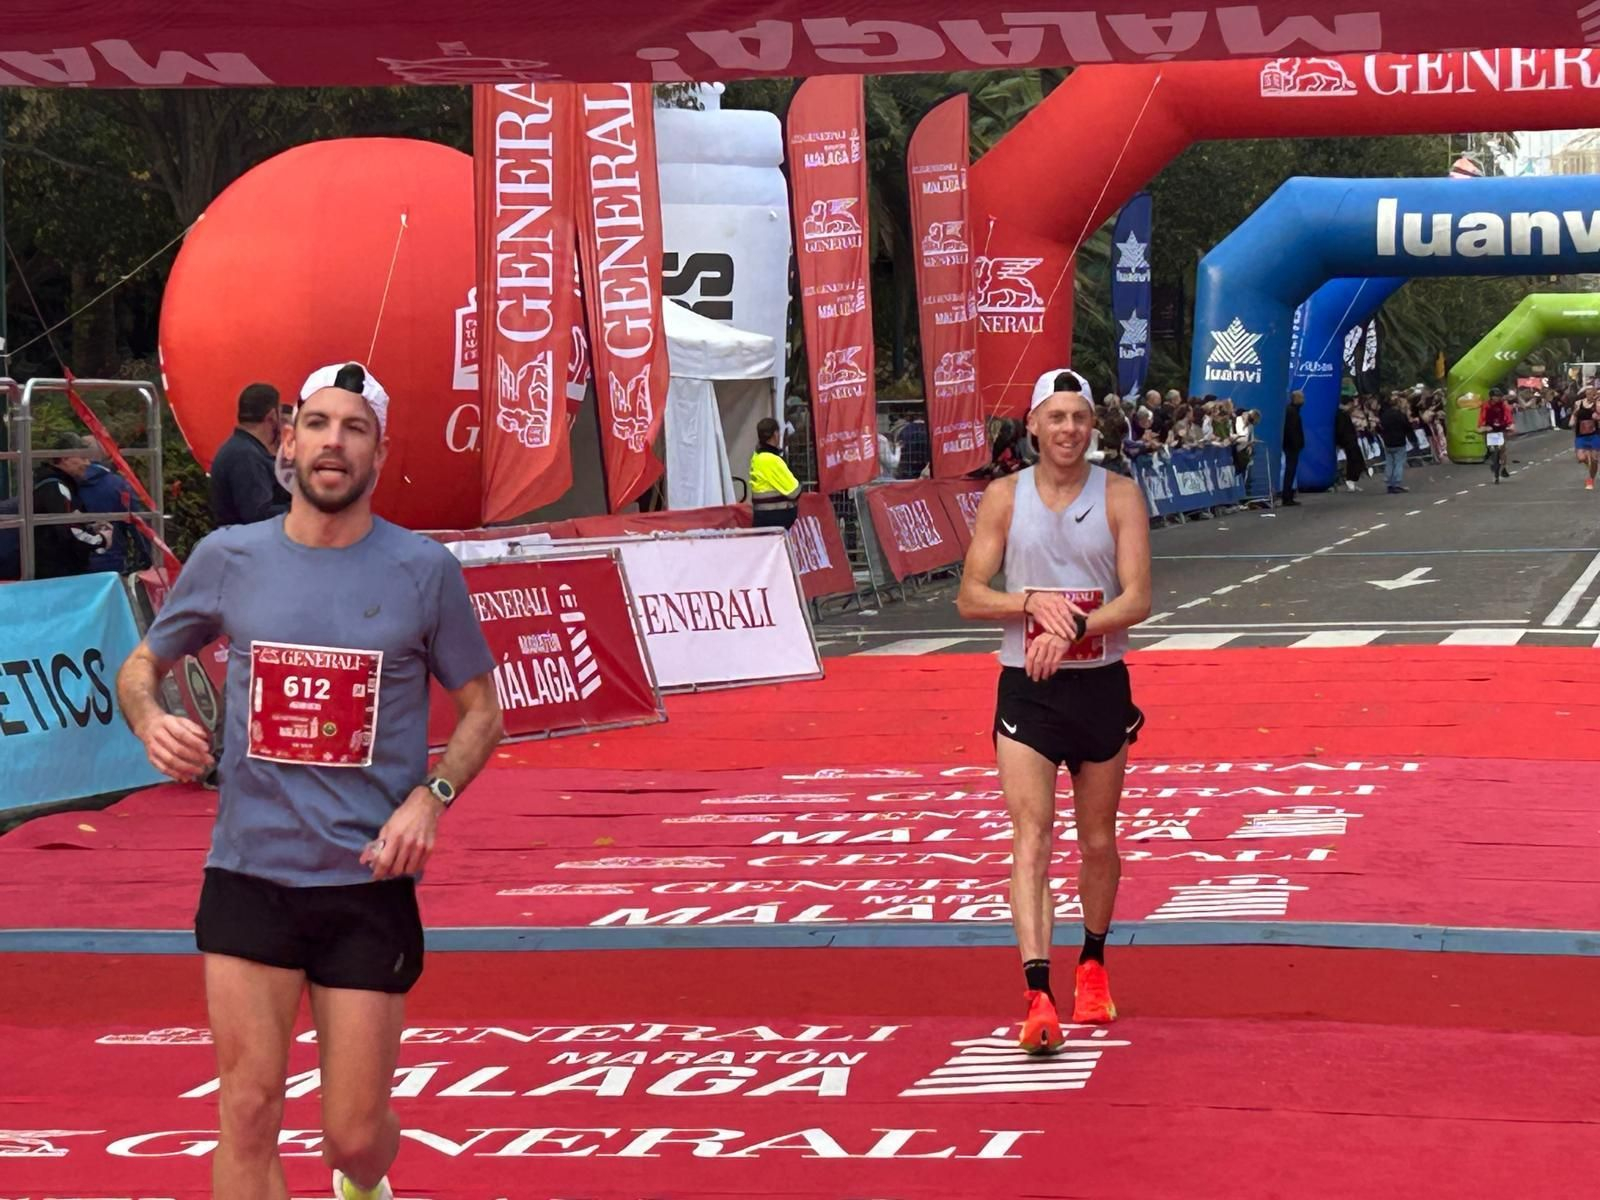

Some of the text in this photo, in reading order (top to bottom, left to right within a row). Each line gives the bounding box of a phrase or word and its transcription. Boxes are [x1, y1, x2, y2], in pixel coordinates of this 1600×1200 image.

[0, 39, 275, 85] MÁ
[1204, 363, 1262, 384] luanvi
[639, 587, 777, 636] ENERALI
[281, 650, 361, 671] GENERALI
[283, 675, 331, 700] 612
[296, 1023, 912, 1044] ENERALI
